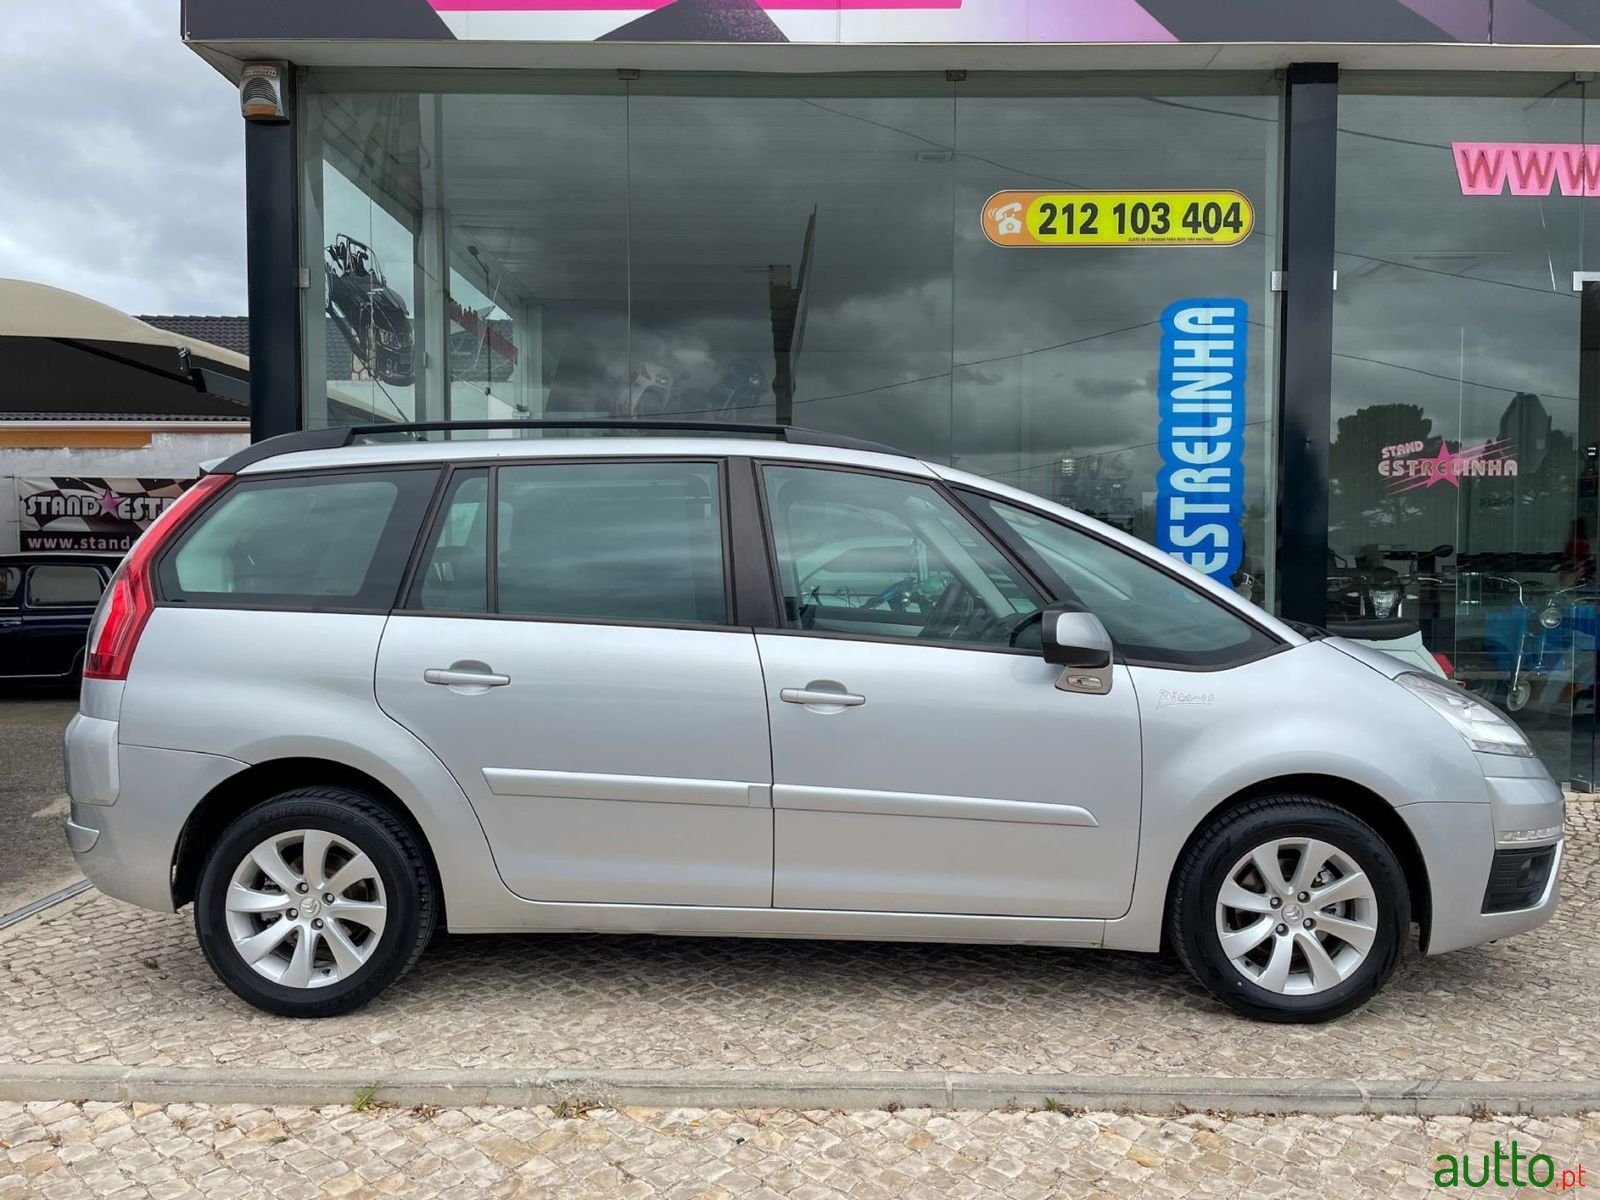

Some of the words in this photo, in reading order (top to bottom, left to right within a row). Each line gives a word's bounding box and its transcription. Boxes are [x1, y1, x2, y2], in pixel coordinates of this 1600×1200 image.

[1038, 202, 1099, 235] 212
[1112, 202, 1171, 235] 103
[1182, 202, 1243, 235] 404
[1170, 307, 1234, 575] ESTRELINHA
[1381, 440, 1424, 459] STAND
[1377, 459, 1518, 477] ESTRELINHA
[26, 495, 100, 516] STAND
[28, 535, 138, 550] www.stand
